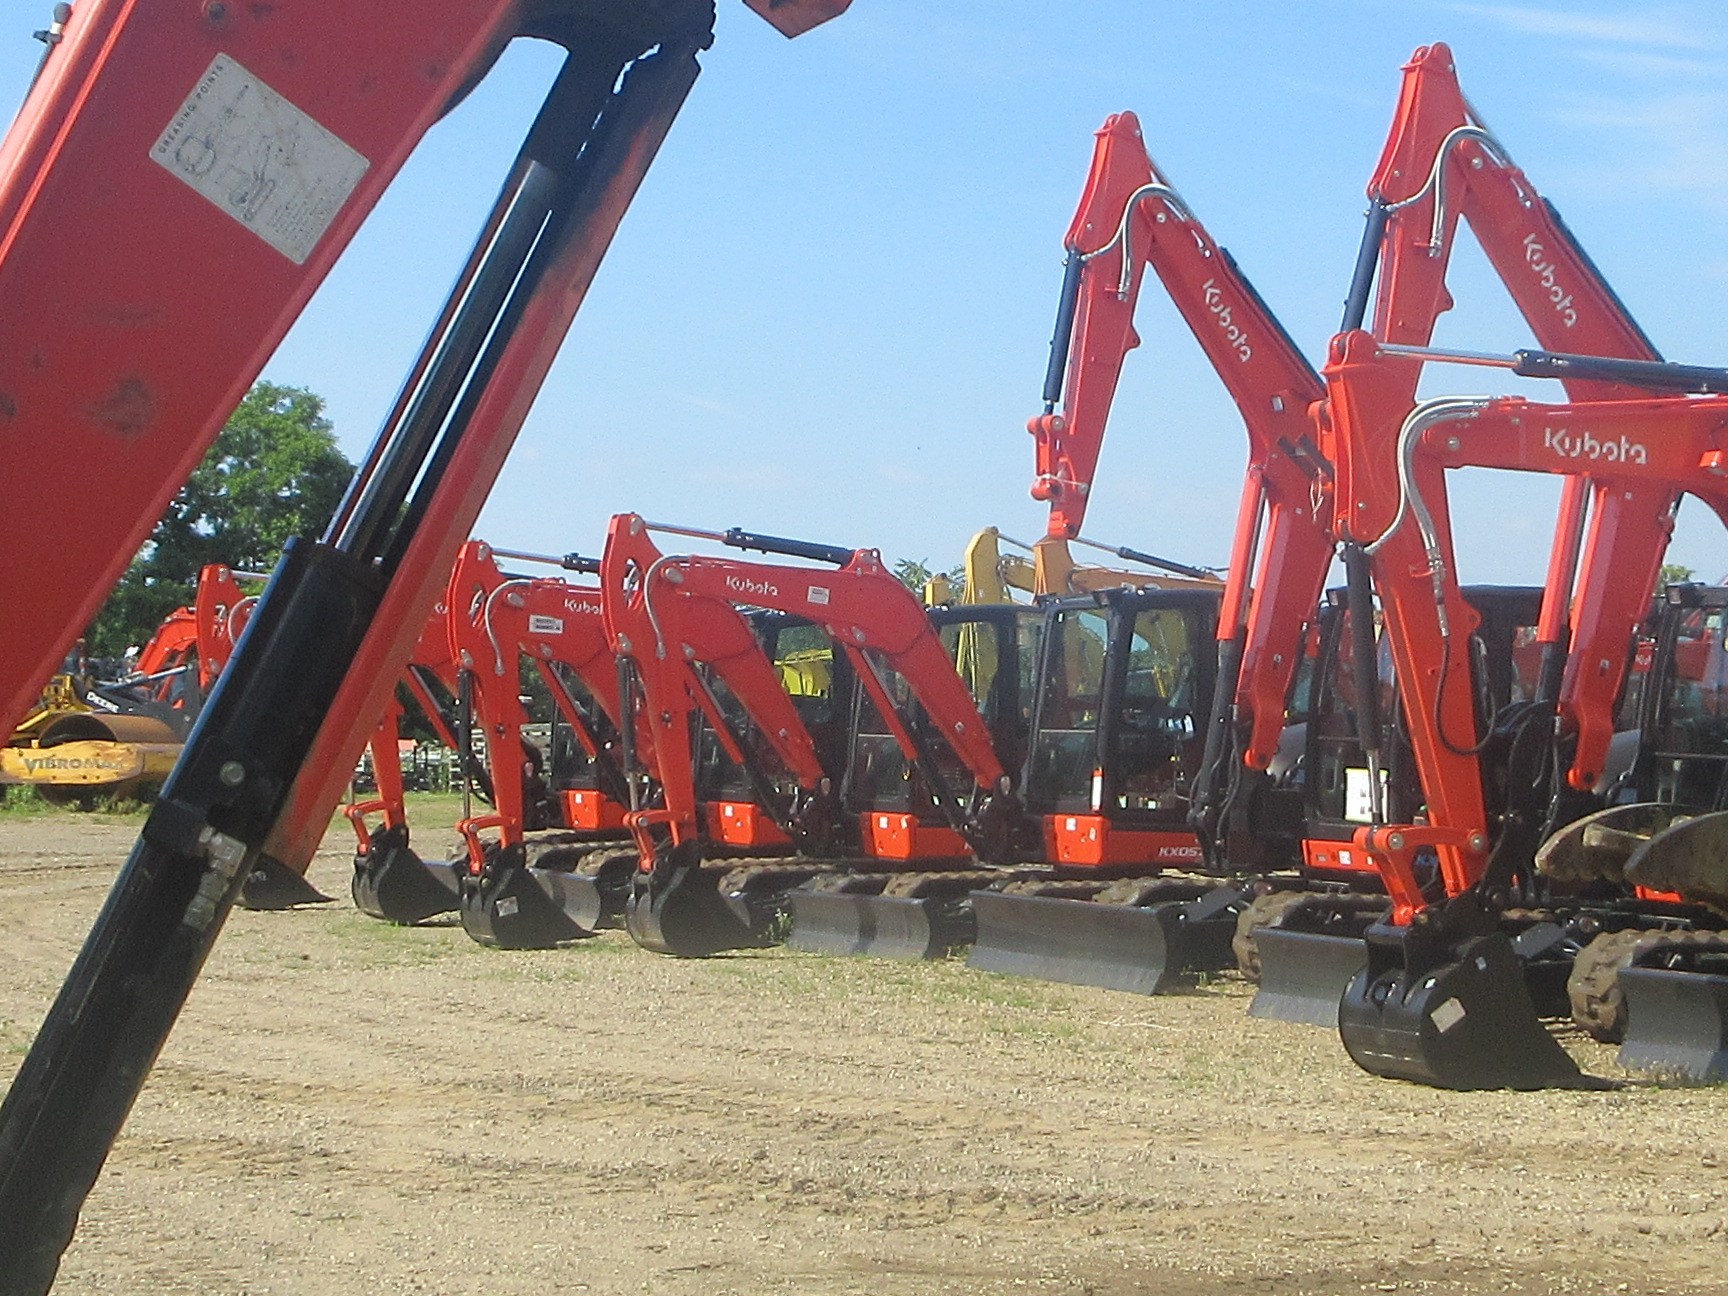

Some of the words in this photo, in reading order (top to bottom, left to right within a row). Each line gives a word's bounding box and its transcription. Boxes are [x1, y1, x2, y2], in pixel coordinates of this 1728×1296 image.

[1523, 232, 1577, 327] Kubota
[1202, 278, 1251, 362] Kubota
[1544, 427, 1647, 465] Kubota
[726, 575, 779, 596] Kubota
[564, 598, 603, 615] Kubot
[86, 691, 120, 713] DEERE
